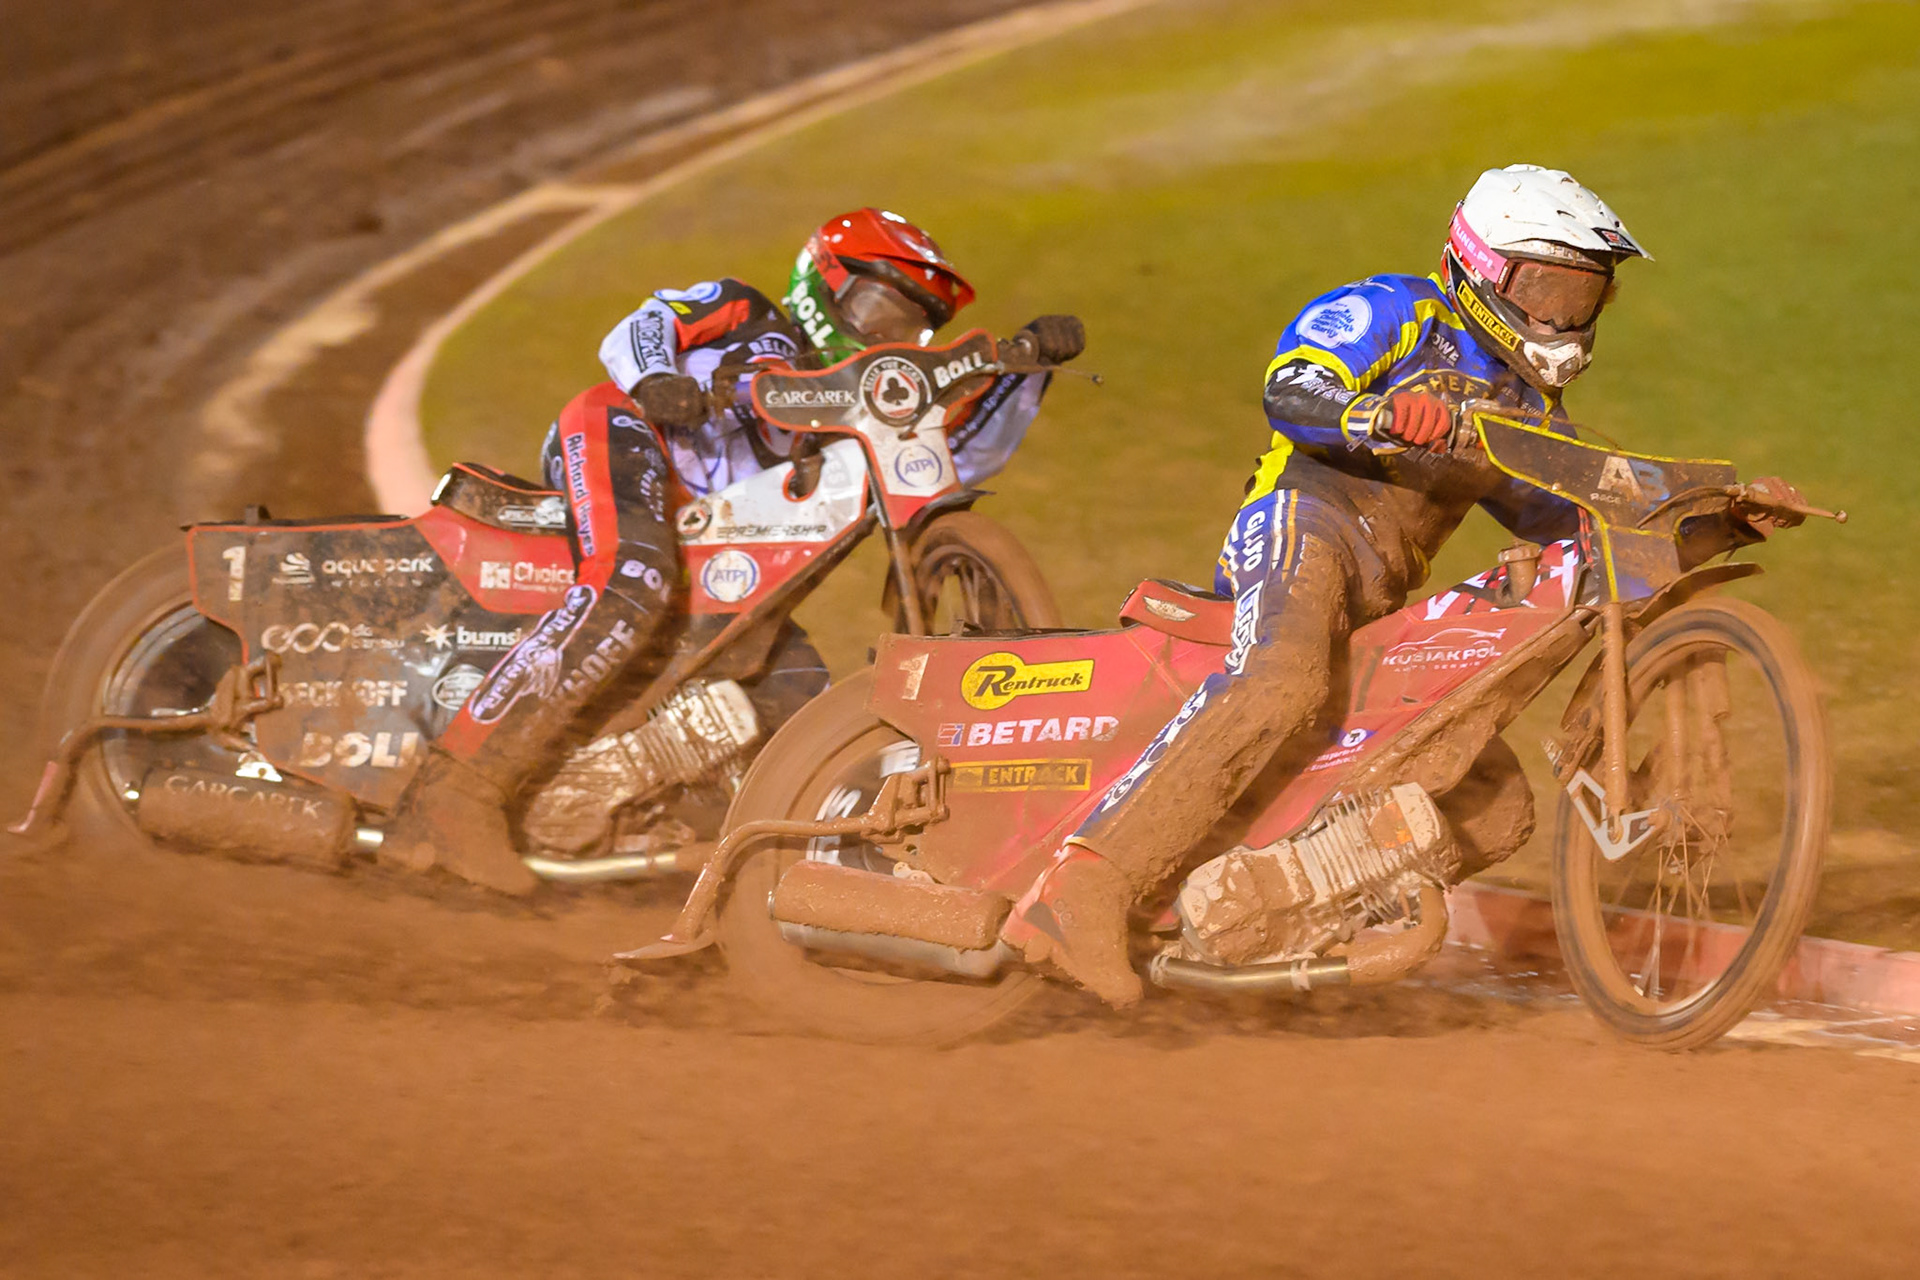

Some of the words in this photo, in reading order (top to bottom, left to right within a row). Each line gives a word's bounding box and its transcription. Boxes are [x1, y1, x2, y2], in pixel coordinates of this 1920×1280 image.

[1471, 303, 1514, 345] ENTRACK
[765, 390, 856, 405] GARCAREK
[222, 546, 246, 601] 1
[898, 653, 929, 700] 1
[974, 665, 1084, 697] Rentruck
[967, 715, 1120, 747] BETARD
[988, 765, 1080, 785] ENTRK
